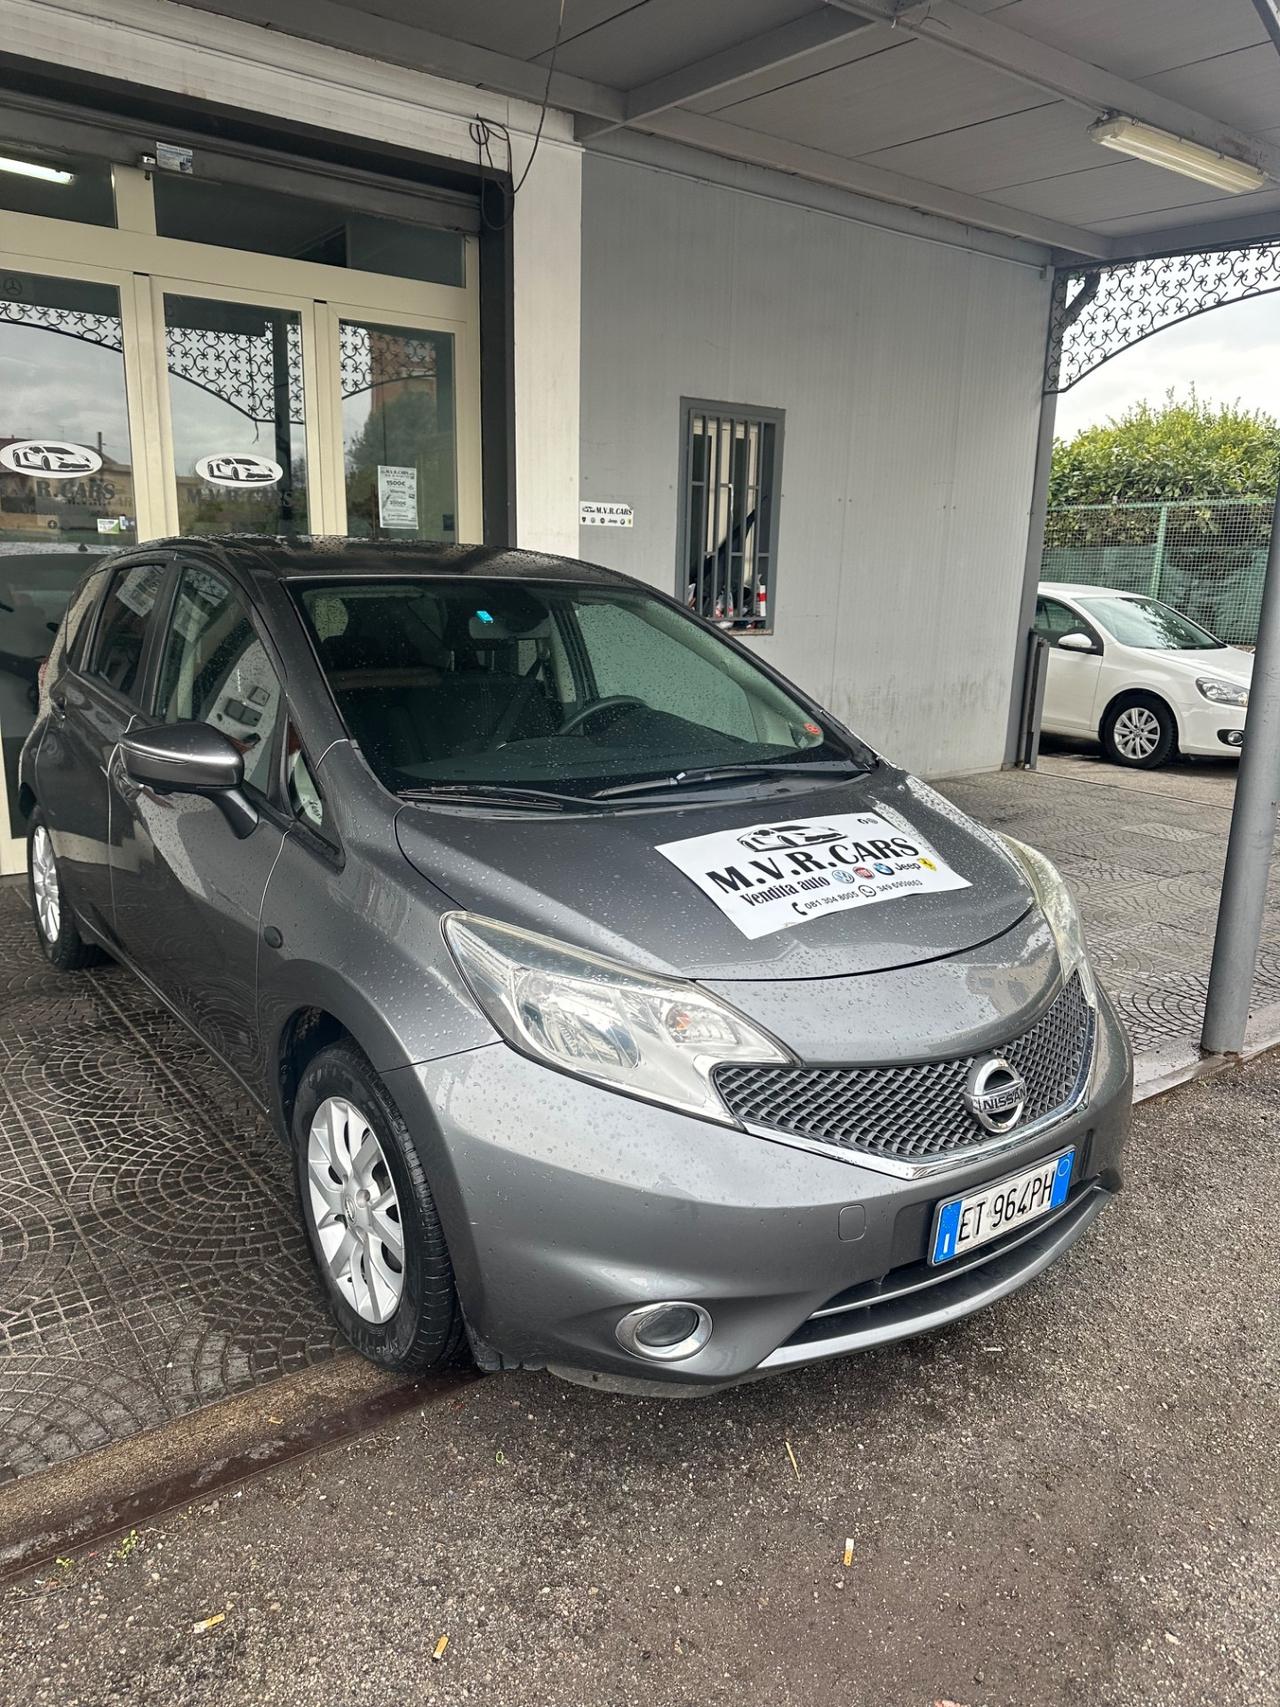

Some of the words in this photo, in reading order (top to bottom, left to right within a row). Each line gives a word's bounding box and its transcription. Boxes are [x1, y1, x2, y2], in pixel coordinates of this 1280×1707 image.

[705, 837, 919, 894] M.V.R.CARS
[894, 862, 921, 871] Jeep
[740, 881, 799, 906] Vendita
[797, 876, 831, 891] auto
[804, 899, 822, 910] 081
[983, 1086, 1027, 1110] NISSAN
[958, 1201, 984, 1242] ET
[991, 1169, 1056, 1229] 964PH
